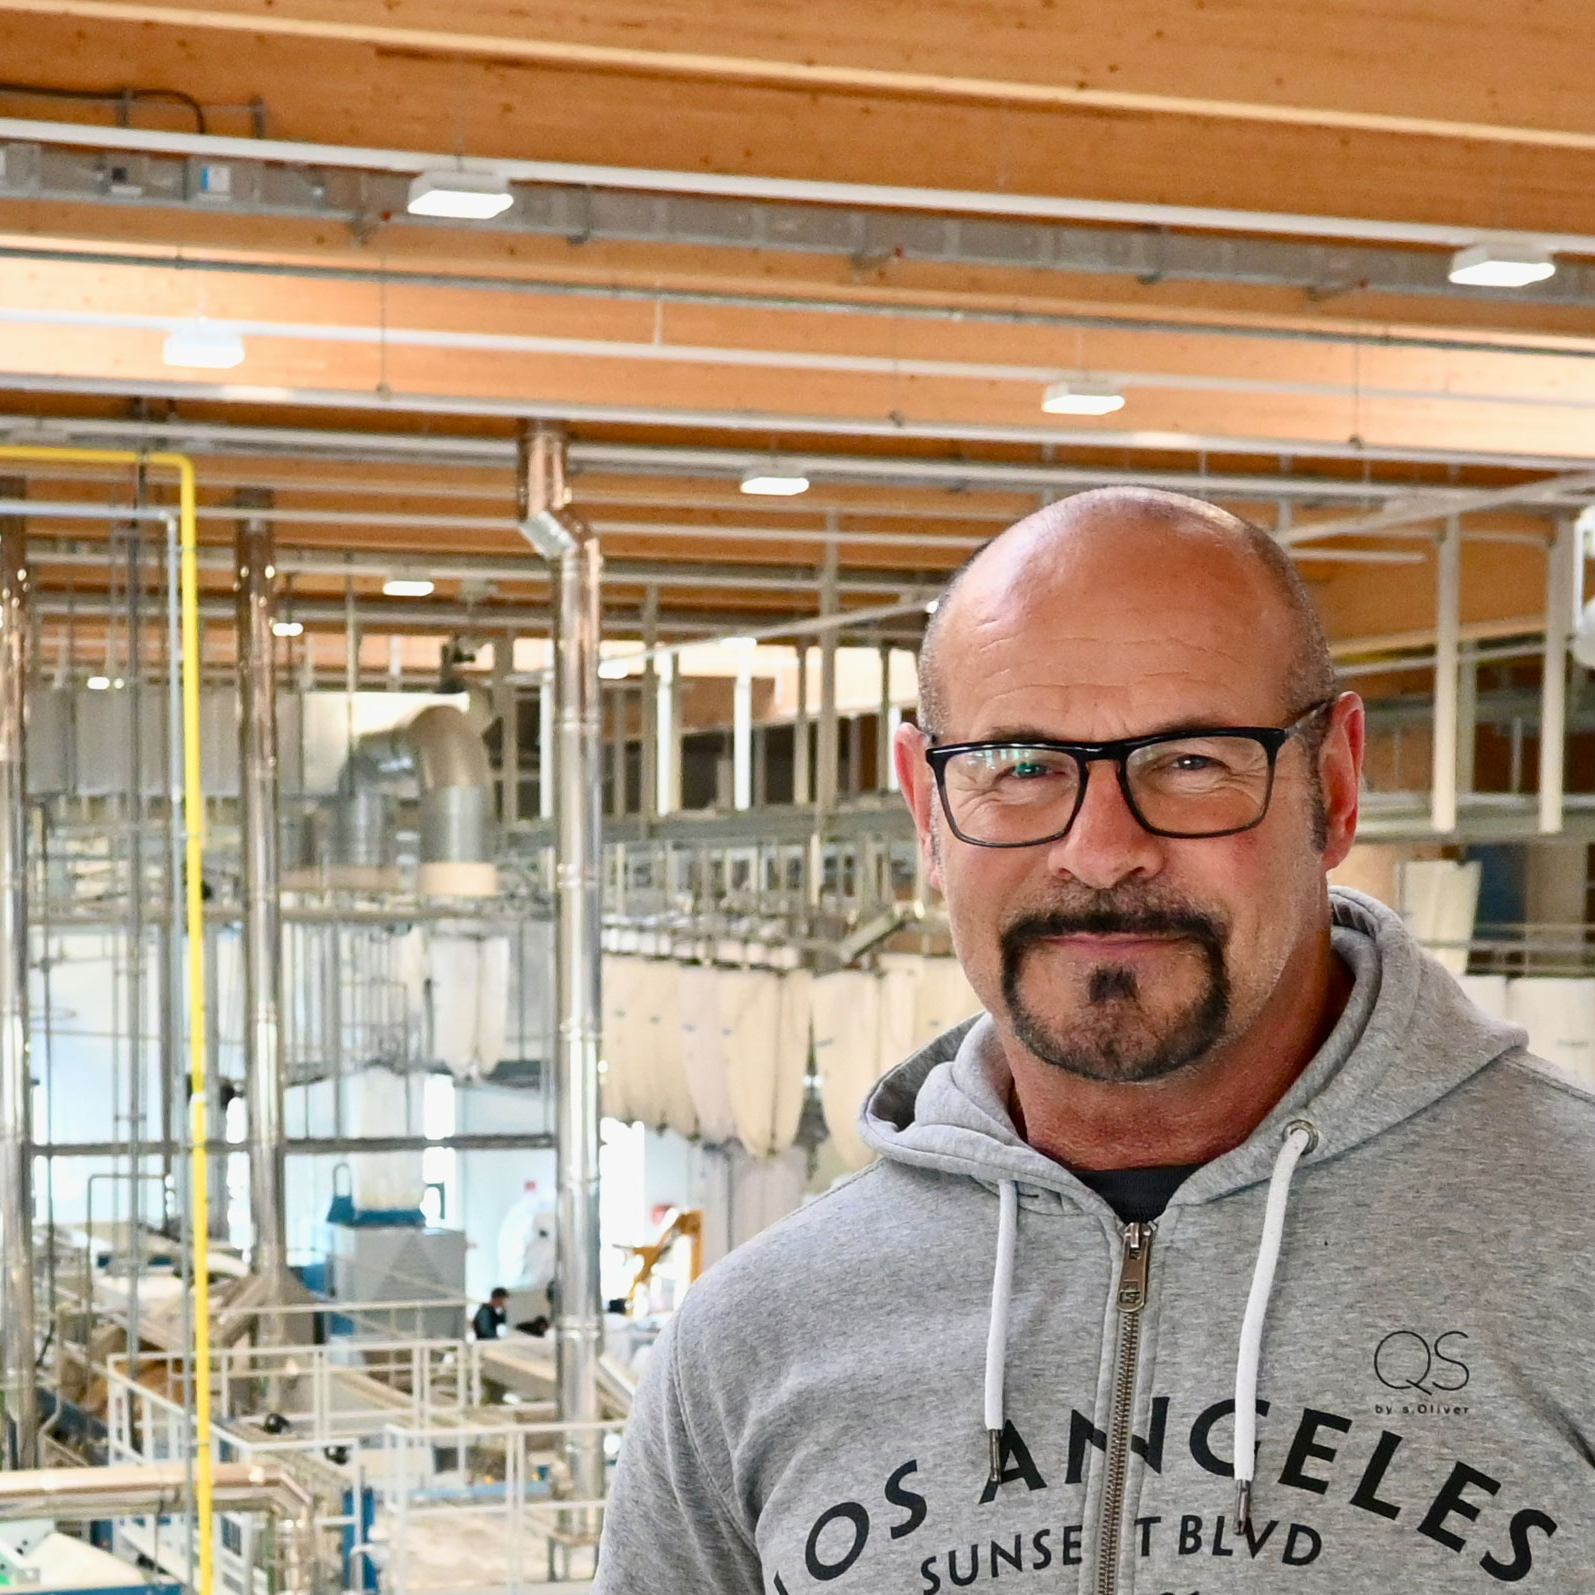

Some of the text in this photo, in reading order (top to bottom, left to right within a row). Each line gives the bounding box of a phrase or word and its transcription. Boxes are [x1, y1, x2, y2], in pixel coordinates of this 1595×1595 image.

[1374, 1330, 1470, 1396] QS
[1375, 1404, 1392, 1415] by
[978, 1396, 1558, 1582] ANGELES
[1178, 1514, 1323, 1567] BLVD
